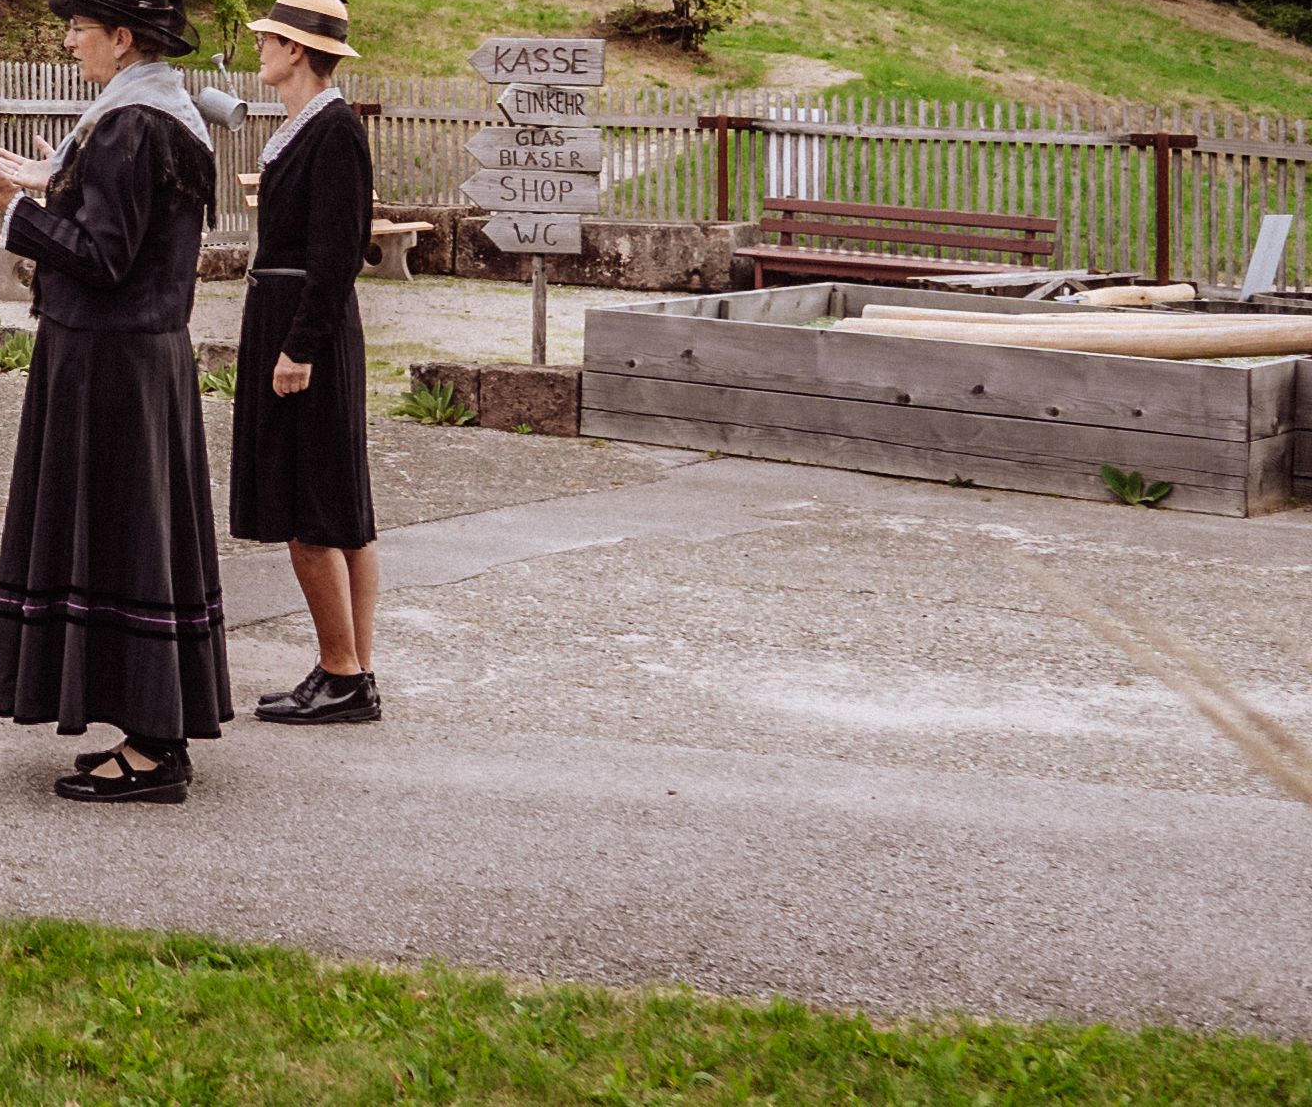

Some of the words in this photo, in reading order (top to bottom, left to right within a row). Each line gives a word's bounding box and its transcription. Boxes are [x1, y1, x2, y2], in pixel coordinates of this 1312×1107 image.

[494, 45, 589, 75] KASSE
[515, 91, 585, 116] EINKEHR
[515, 129, 579, 147] GLAS-
[499, 149, 584, 168] BLÄSER
[500, 175, 573, 203] SHOP
[512, 222, 558, 247] WC
